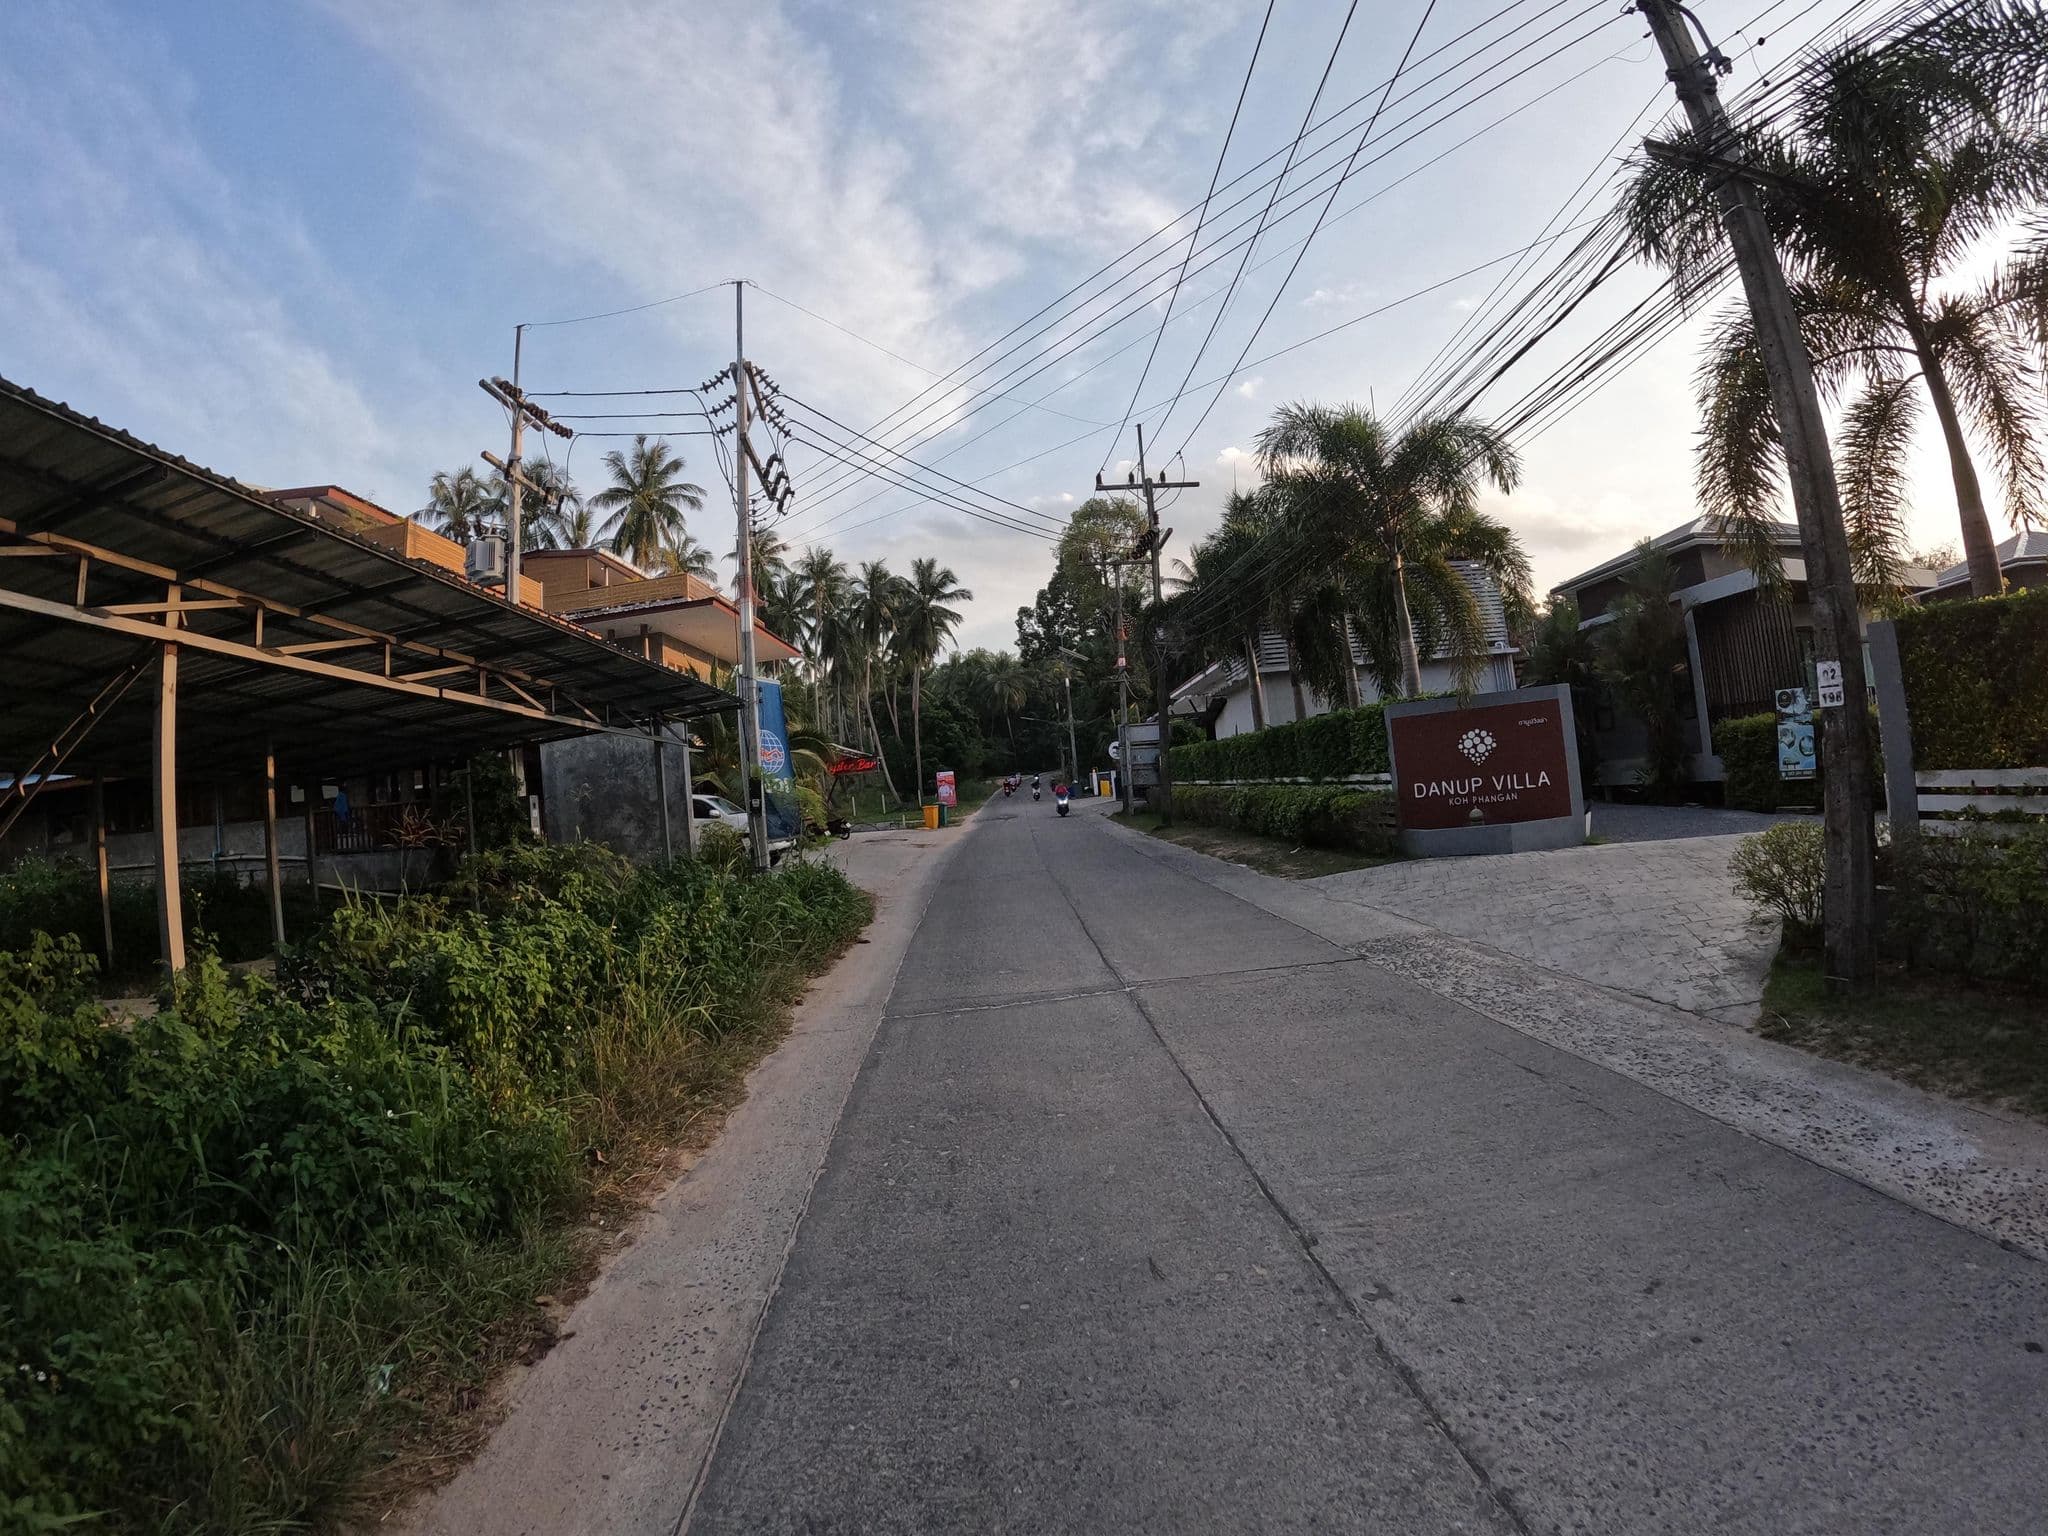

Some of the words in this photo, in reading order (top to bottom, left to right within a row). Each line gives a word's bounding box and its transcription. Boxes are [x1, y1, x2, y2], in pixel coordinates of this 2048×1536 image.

[1414, 777, 1483, 799] DANUP
[1492, 770, 1551, 791] VILLA
[1449, 796, 1469, 807] KOH
[1472, 792, 1518, 805] PHANGAN
